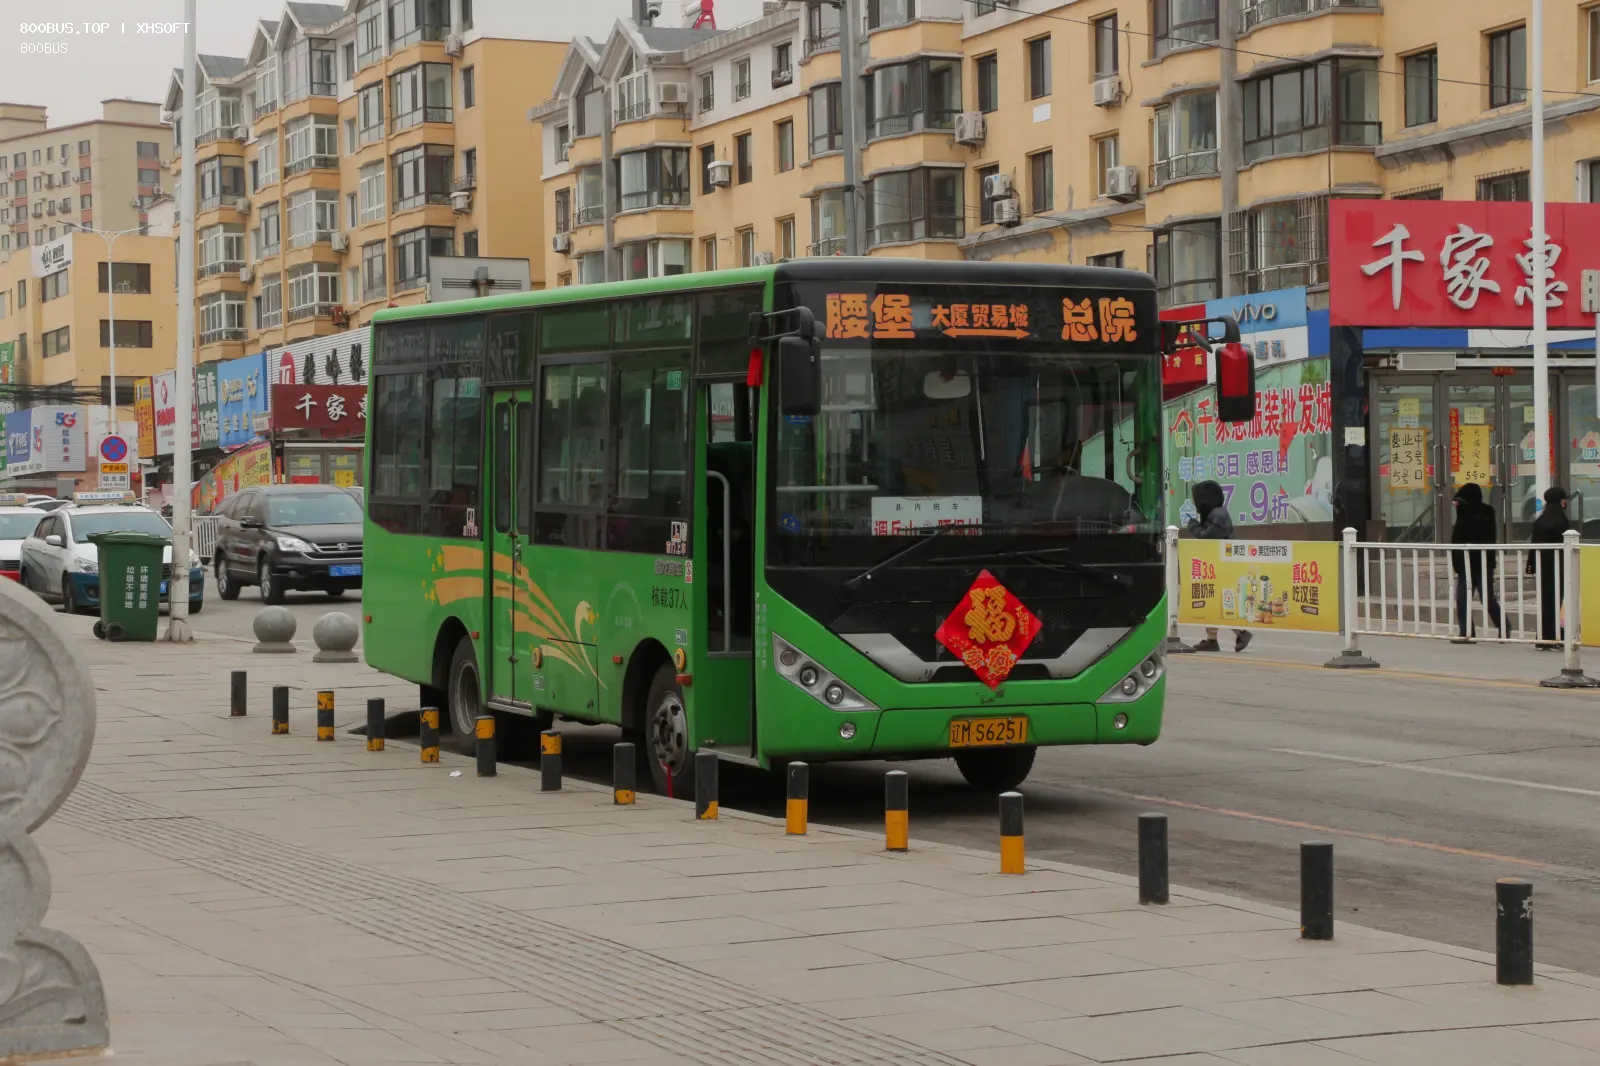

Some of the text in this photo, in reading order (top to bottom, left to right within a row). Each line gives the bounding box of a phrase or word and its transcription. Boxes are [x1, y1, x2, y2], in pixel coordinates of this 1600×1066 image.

[825, 293, 916, 339] 腰堡
[930, 303, 1029, 328] 大厦贸易城
[1061, 297, 1137, 343] 总院
[1232, 302, 1278, 323] vivo
[1197, 381, 1332, 446] 千服装批发城
[1179, 453, 1240, 481] 每月15日
[1246, 449, 1289, 477] 感恩日
[1391, 450, 1423, 466] 走3号
[1392, 468, 1423, 485] 5号口
[1218, 482, 1289, 523] 7.9折
[1233, 544, 1245, 556] 美团
[124, 566, 135, 609] 垃圾不落地
[139, 566, 148, 609] 环境更美丽
[652, 586, 688, 611] 核载37人
[1191, 583, 1215, 599] 喝奶茶
[1292, 585, 1319, 605] 吃汉堡
